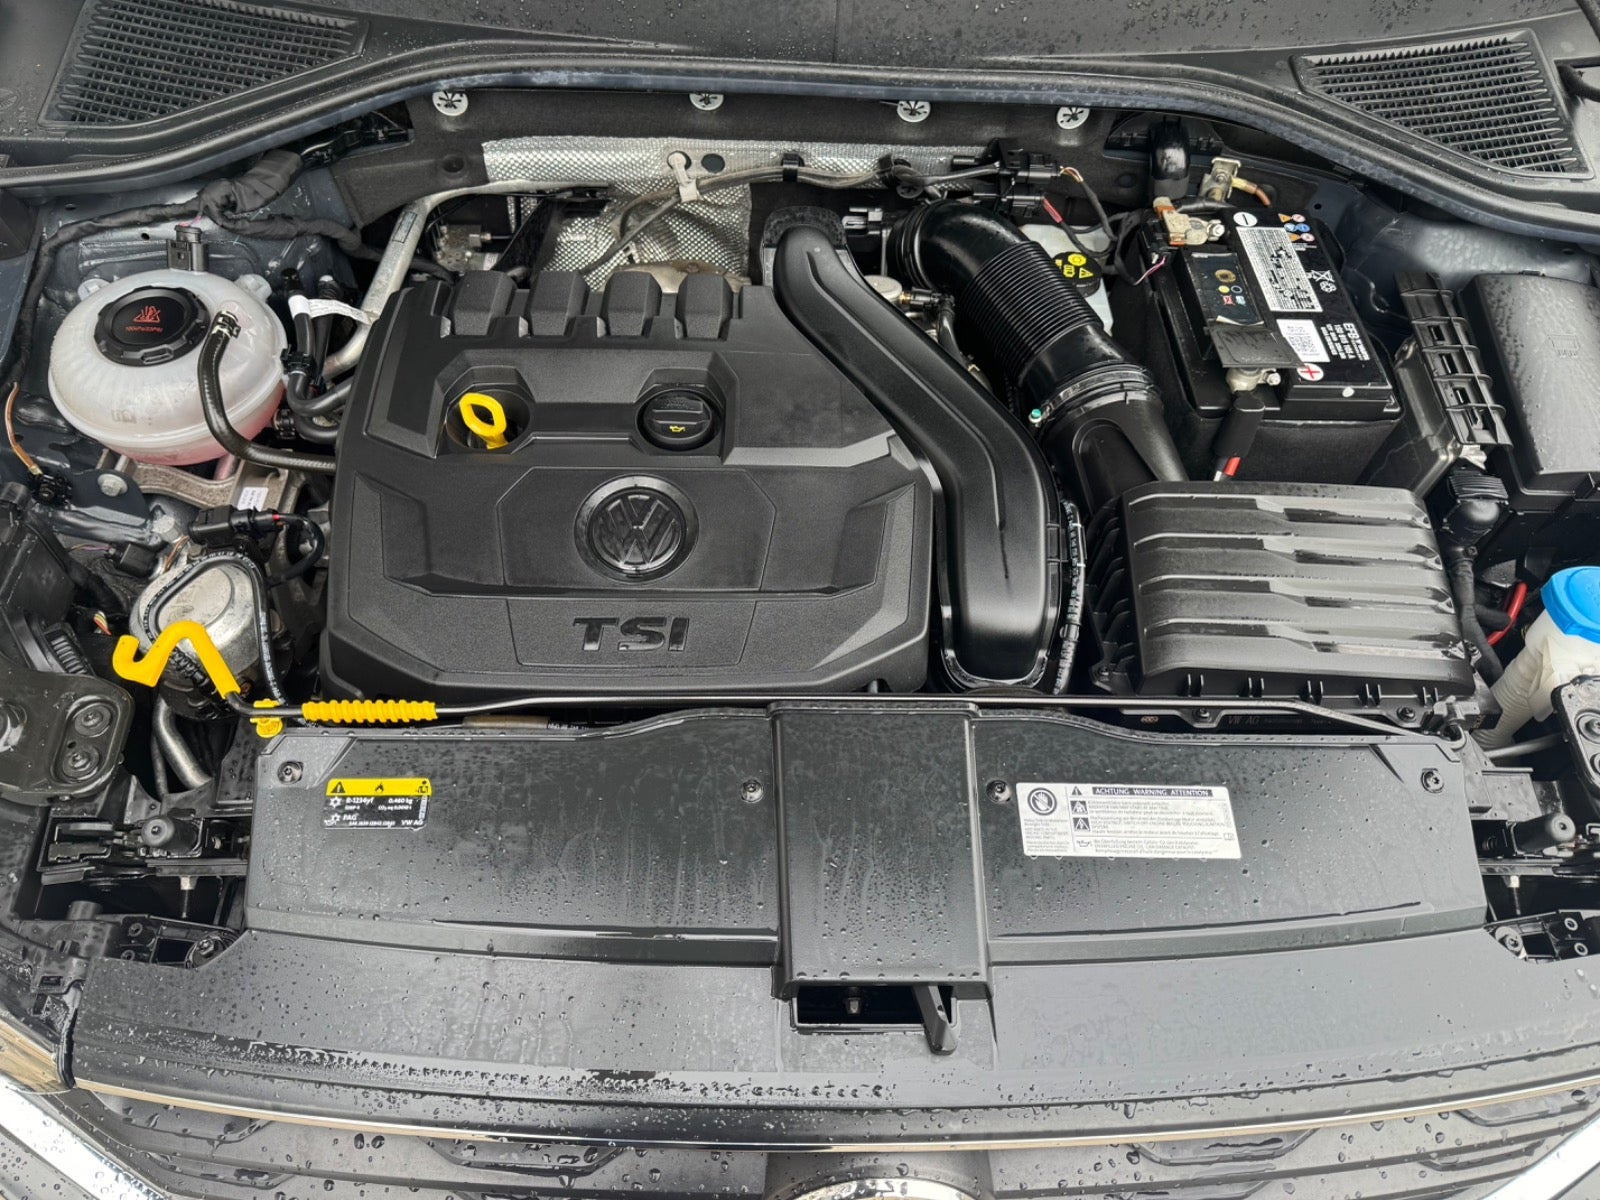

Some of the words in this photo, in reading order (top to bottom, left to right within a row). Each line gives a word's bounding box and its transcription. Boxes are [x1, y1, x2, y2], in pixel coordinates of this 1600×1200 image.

[1343, 323, 1360, 339] EFB
[573, 617, 690, 651] TSI
[1095, 787, 1130, 795] ACHTUNG
[1133, 788, 1167, 796] WARNING
[1170, 789, 1209, 797] ATTENTION
